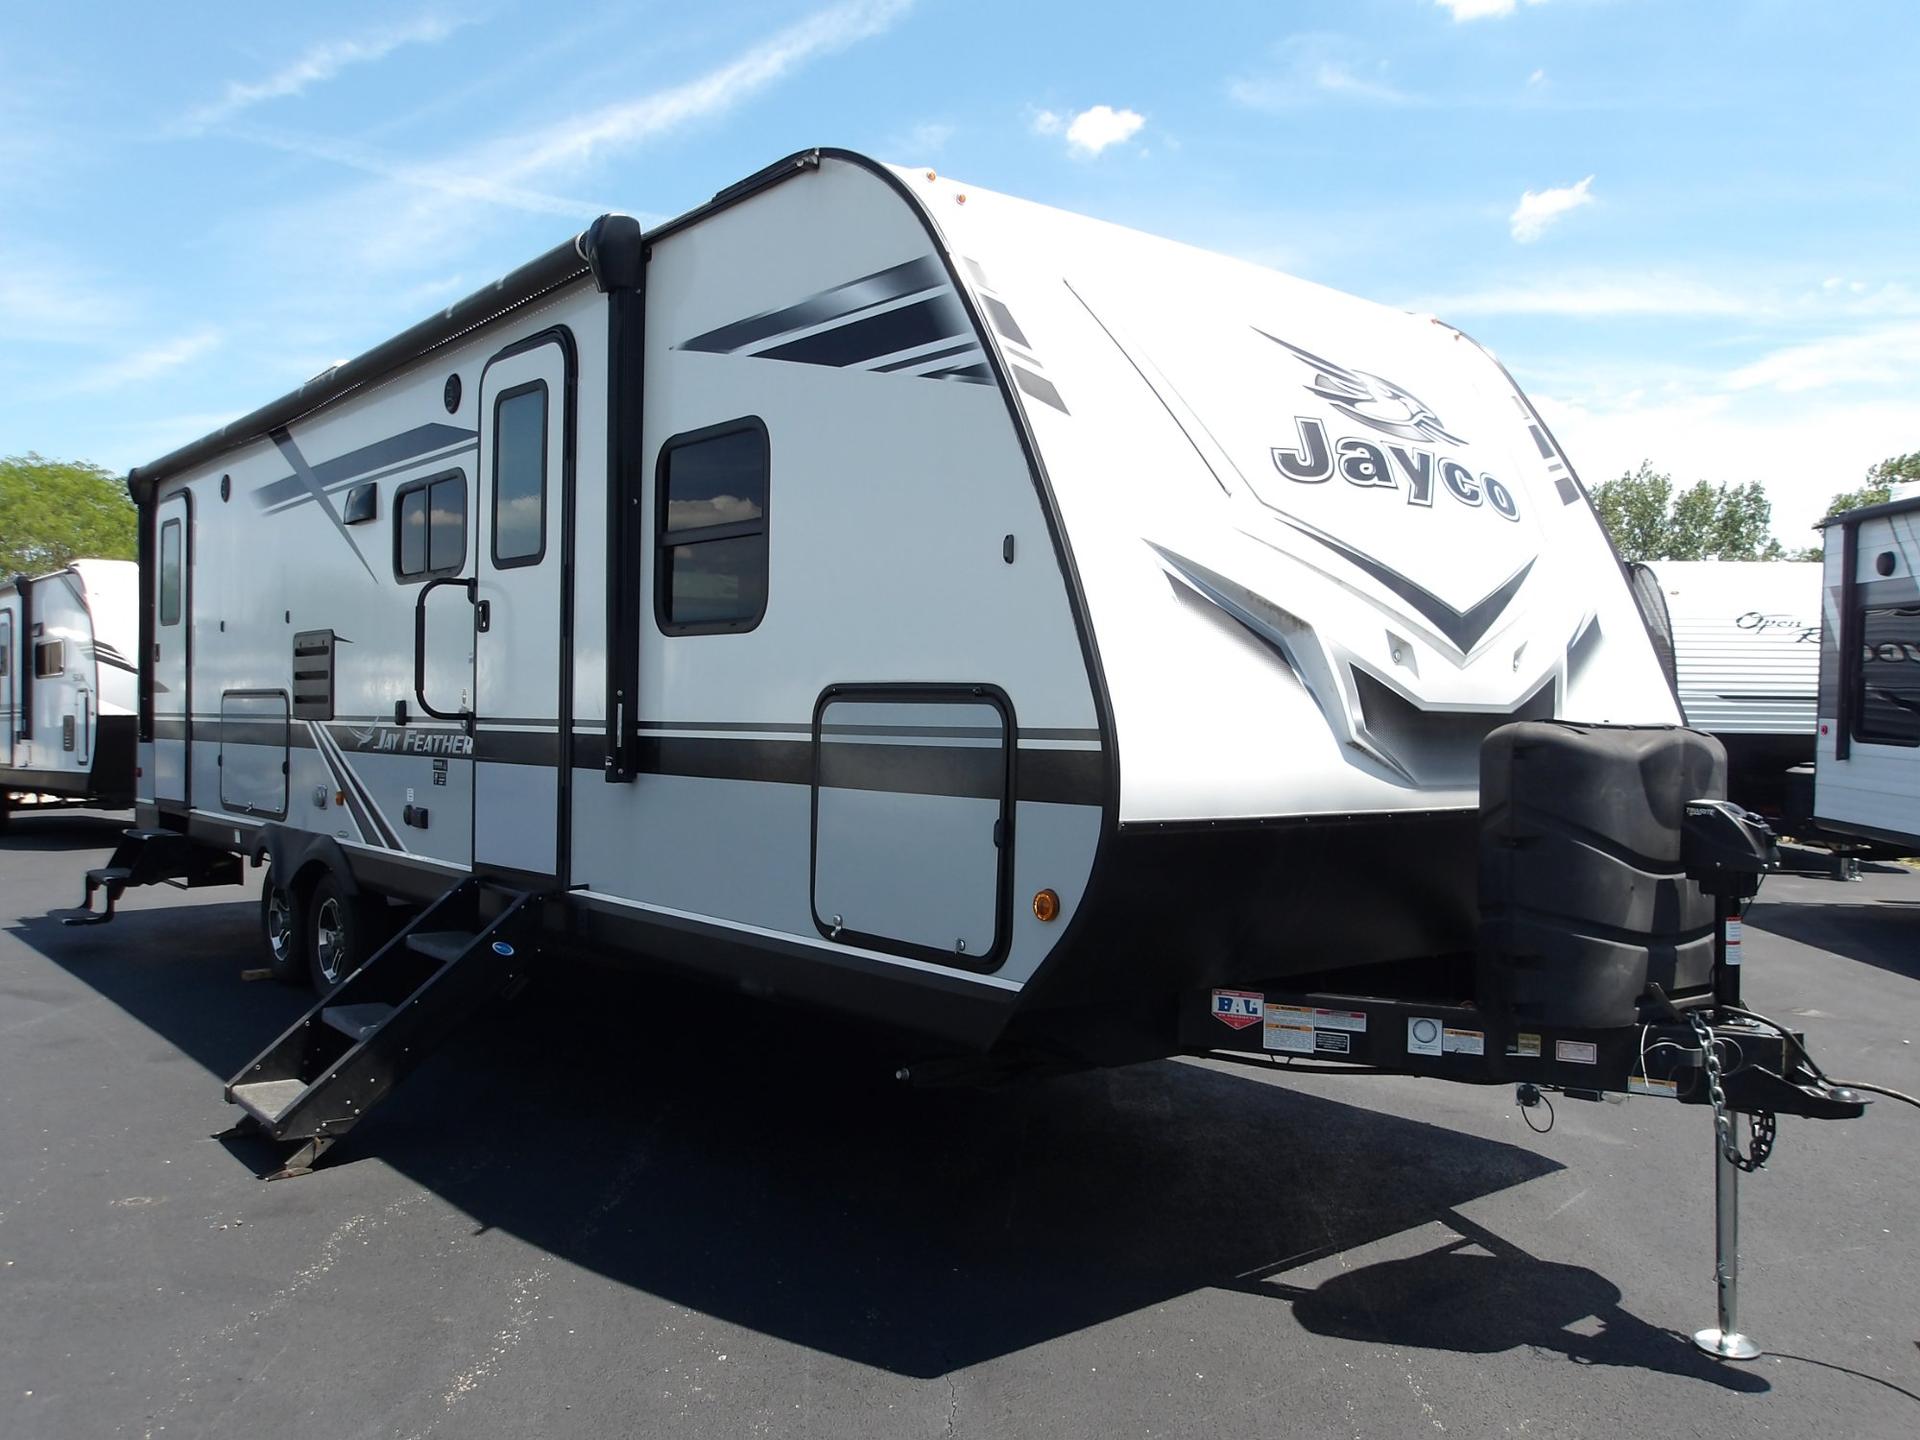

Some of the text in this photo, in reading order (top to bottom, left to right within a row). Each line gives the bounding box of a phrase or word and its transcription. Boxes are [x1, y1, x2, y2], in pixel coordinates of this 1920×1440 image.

[1270, 416, 1520, 522] Jayco
[1736, 612, 1802, 634] Open
[373, 729, 473, 755] JAY FEATHER
[1217, 996, 1258, 1014] BAL
